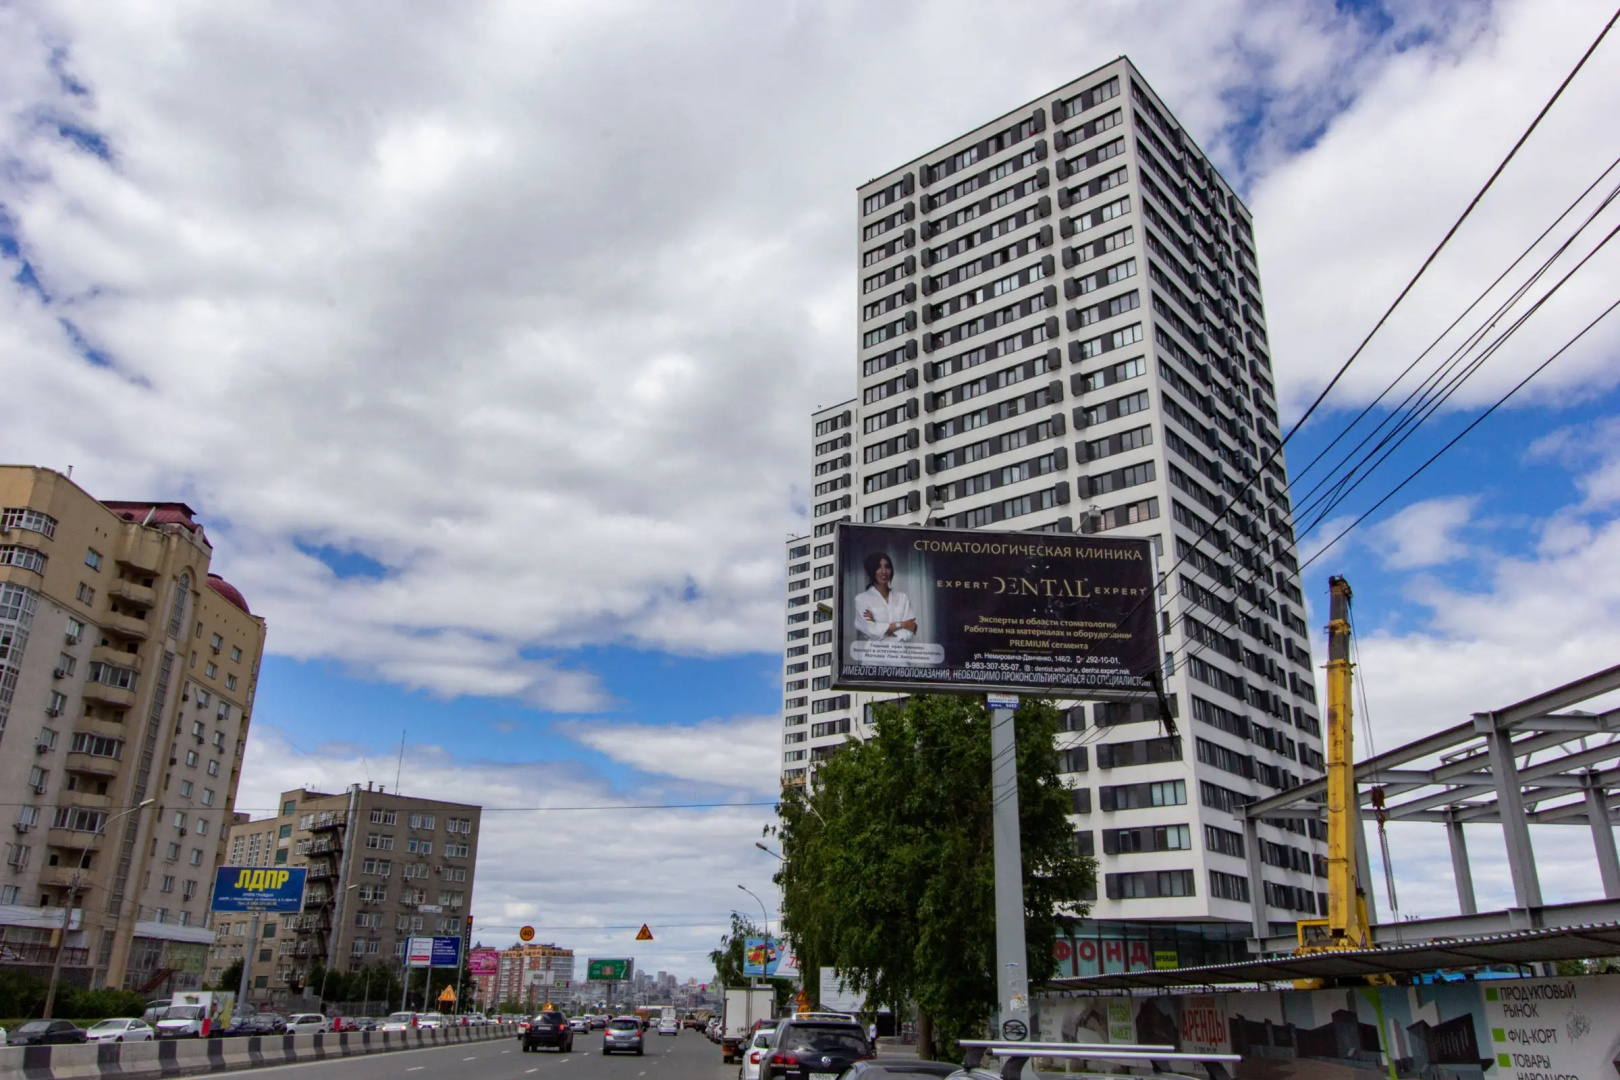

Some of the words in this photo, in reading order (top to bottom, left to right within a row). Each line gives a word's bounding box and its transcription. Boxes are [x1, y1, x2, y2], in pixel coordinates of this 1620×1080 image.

[913, 540, 1072, 558] СТОМАТОЛОГИЧЕСКАЯ
[1076, 547, 1143, 561] КЛИНИКА
[936, 579, 989, 589] EXPERT
[992, 576, 1091, 598] DENTAL
[1094, 586, 1147, 596] EXPERT
[979, 615, 1018, 626] Эксперты
[1026, 618, 1058, 626] области
[1060, 620, 1116, 629] стоматологии
[964, 625, 1004, 634] Работаем
[1017, 628, 1065, 637] материалах
[1009, 639, 1050, 649] PREMIUM
[1051, 642, 1088, 650] сегмента
[842, 665, 877, 676] ИМЕЮТСЯ
[878, 667, 952, 680] ПРОТИВОПОКАЗАНИЯ,
[953, 669, 1000, 682] НЕОБХОДИМО
[234, 869, 289, 891] ЛДПР
[522, 929, 531, 937] 40
[1053, 941, 1148, 966] ФОНД
[1500, 981, 1577, 1002] ПРОДУКТОВЫЙ
[1503, 1003, 1540, 1018] РЫНОК
[1181, 1009, 1227, 1047] АРЕНДЫ
[1508, 1029, 1558, 1045] ФУД-КОРТ
[1511, 1053, 1552, 1069] ТОВАРЫ
